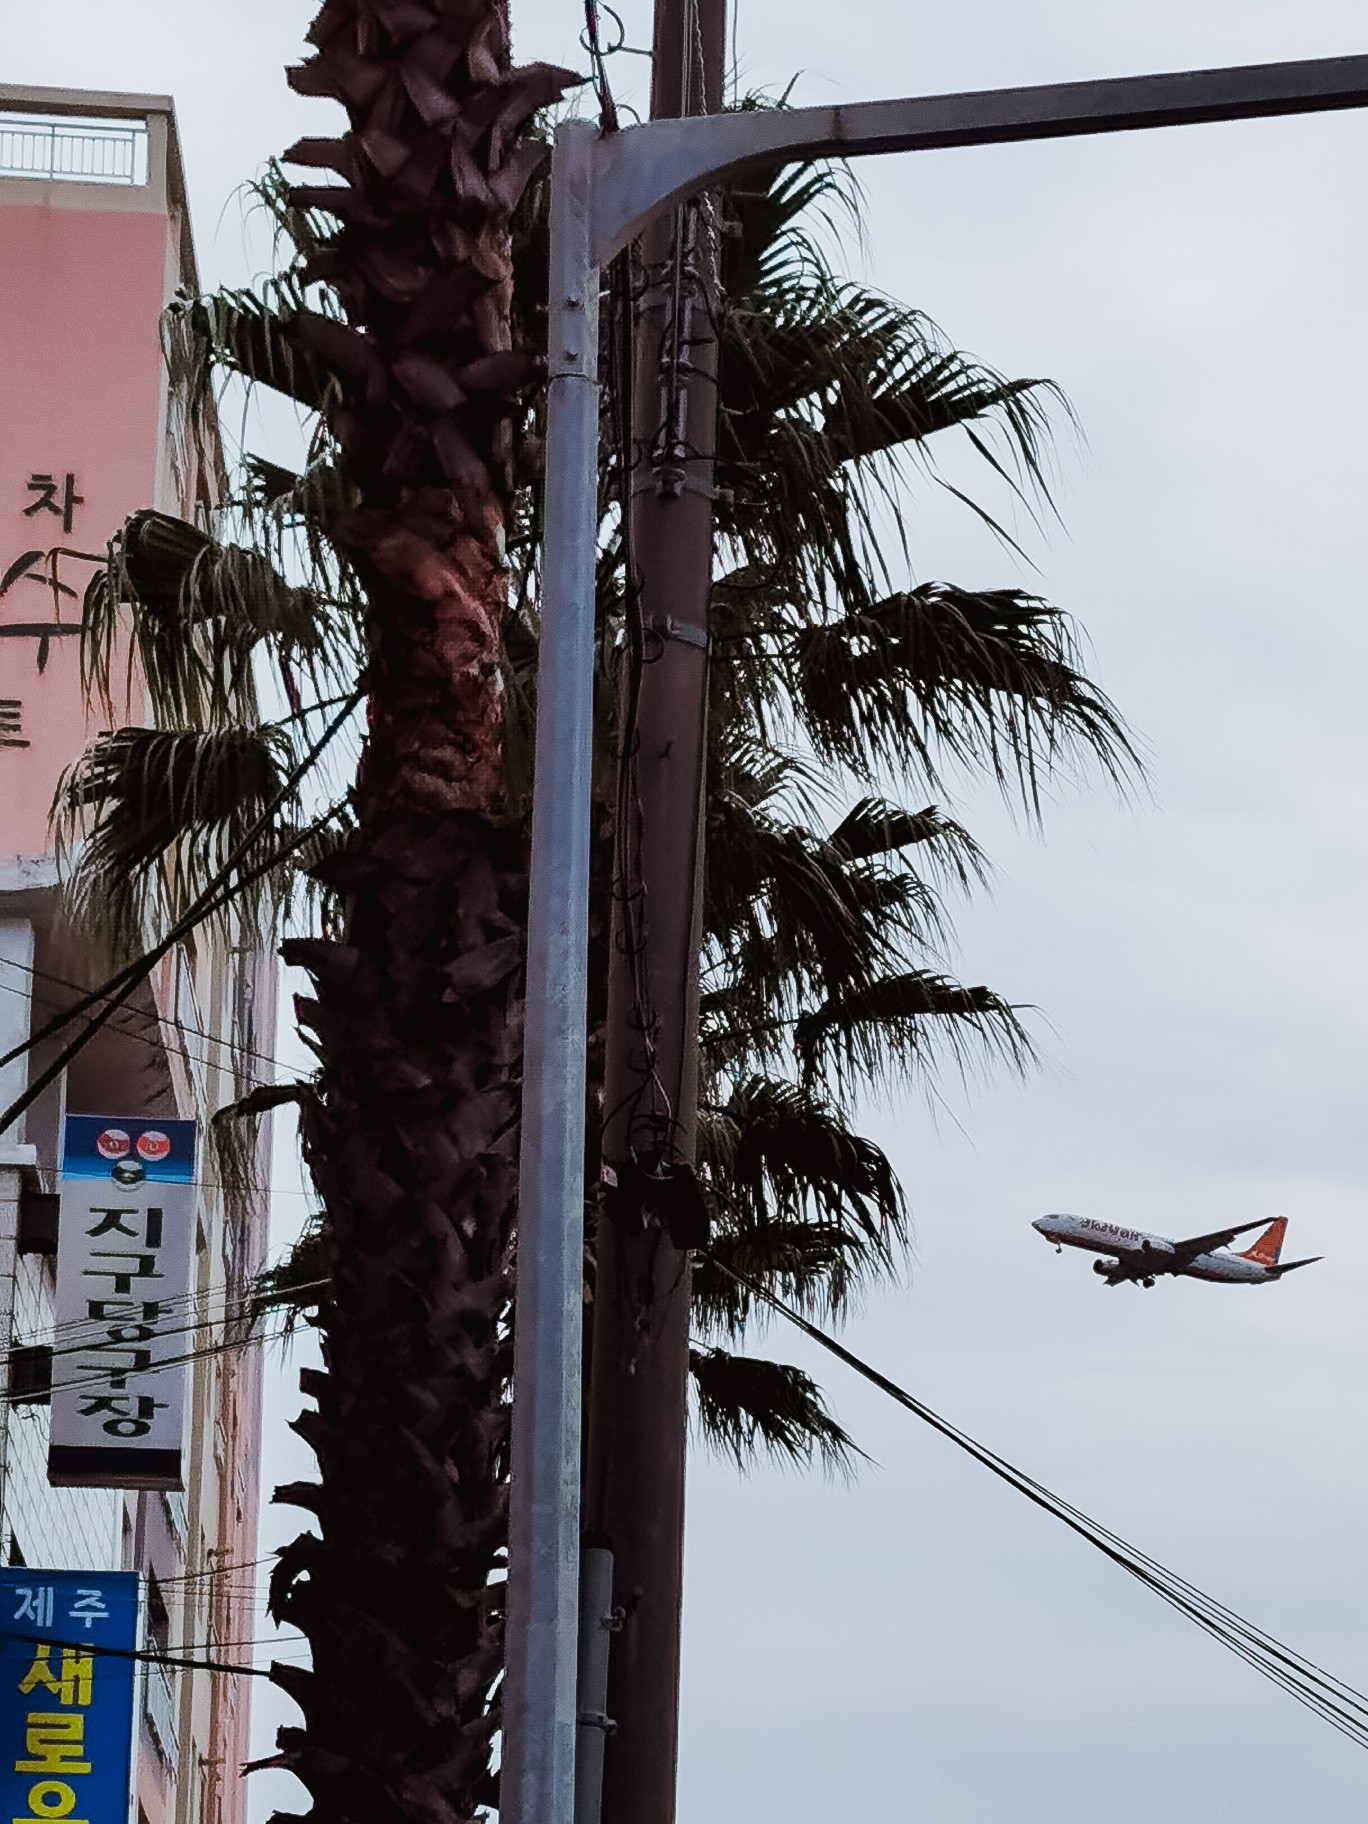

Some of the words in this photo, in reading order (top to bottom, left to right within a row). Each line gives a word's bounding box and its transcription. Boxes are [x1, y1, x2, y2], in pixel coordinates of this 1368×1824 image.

[22, 473, 84, 534] 차
[77, 1207, 173, 1438] 지구당구장
[13, 1586, 110, 1629] 제주
